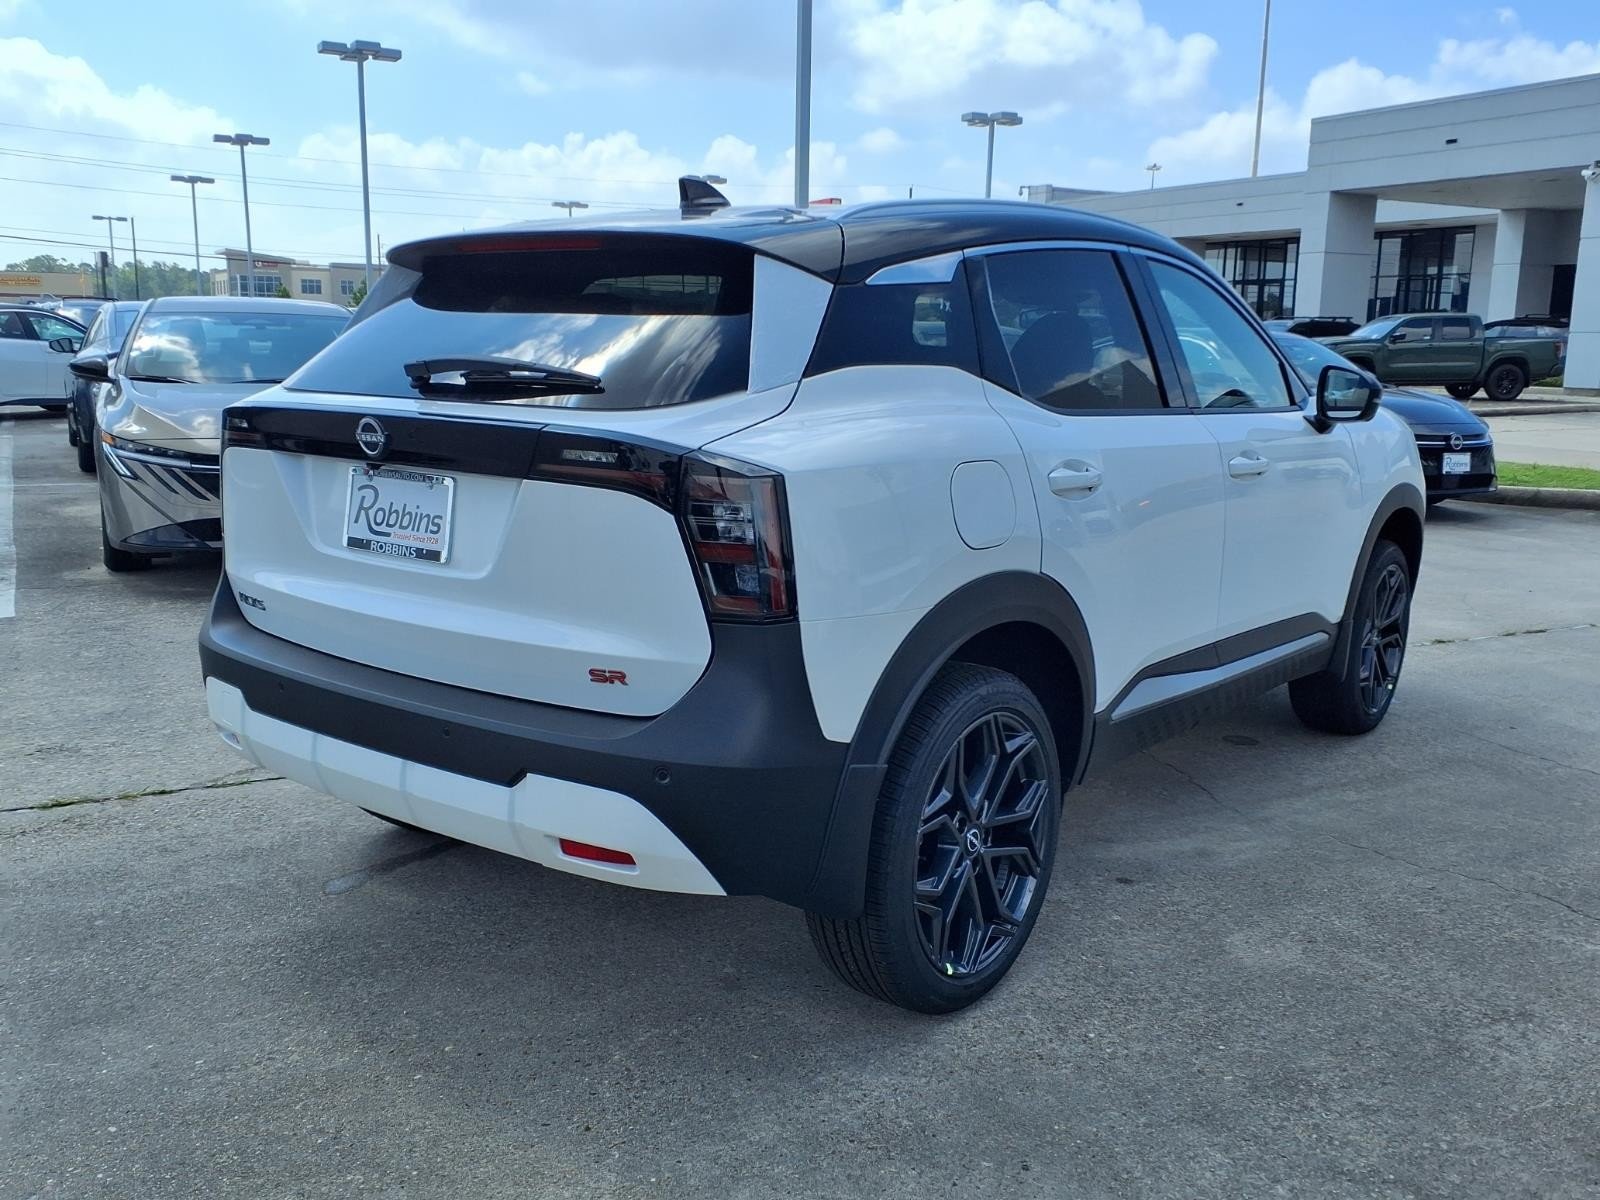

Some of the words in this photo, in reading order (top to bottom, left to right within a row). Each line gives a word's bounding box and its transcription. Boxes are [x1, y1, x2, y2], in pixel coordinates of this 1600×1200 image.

[355, 433, 385, 443] NISSAN
[354, 484, 443, 537] Robbins
[392, 533, 411, 541] Trusted
[412, 534, 426, 543] Since
[370, 541, 416, 558] ROBBINS
[588, 668, 629, 686] SR
